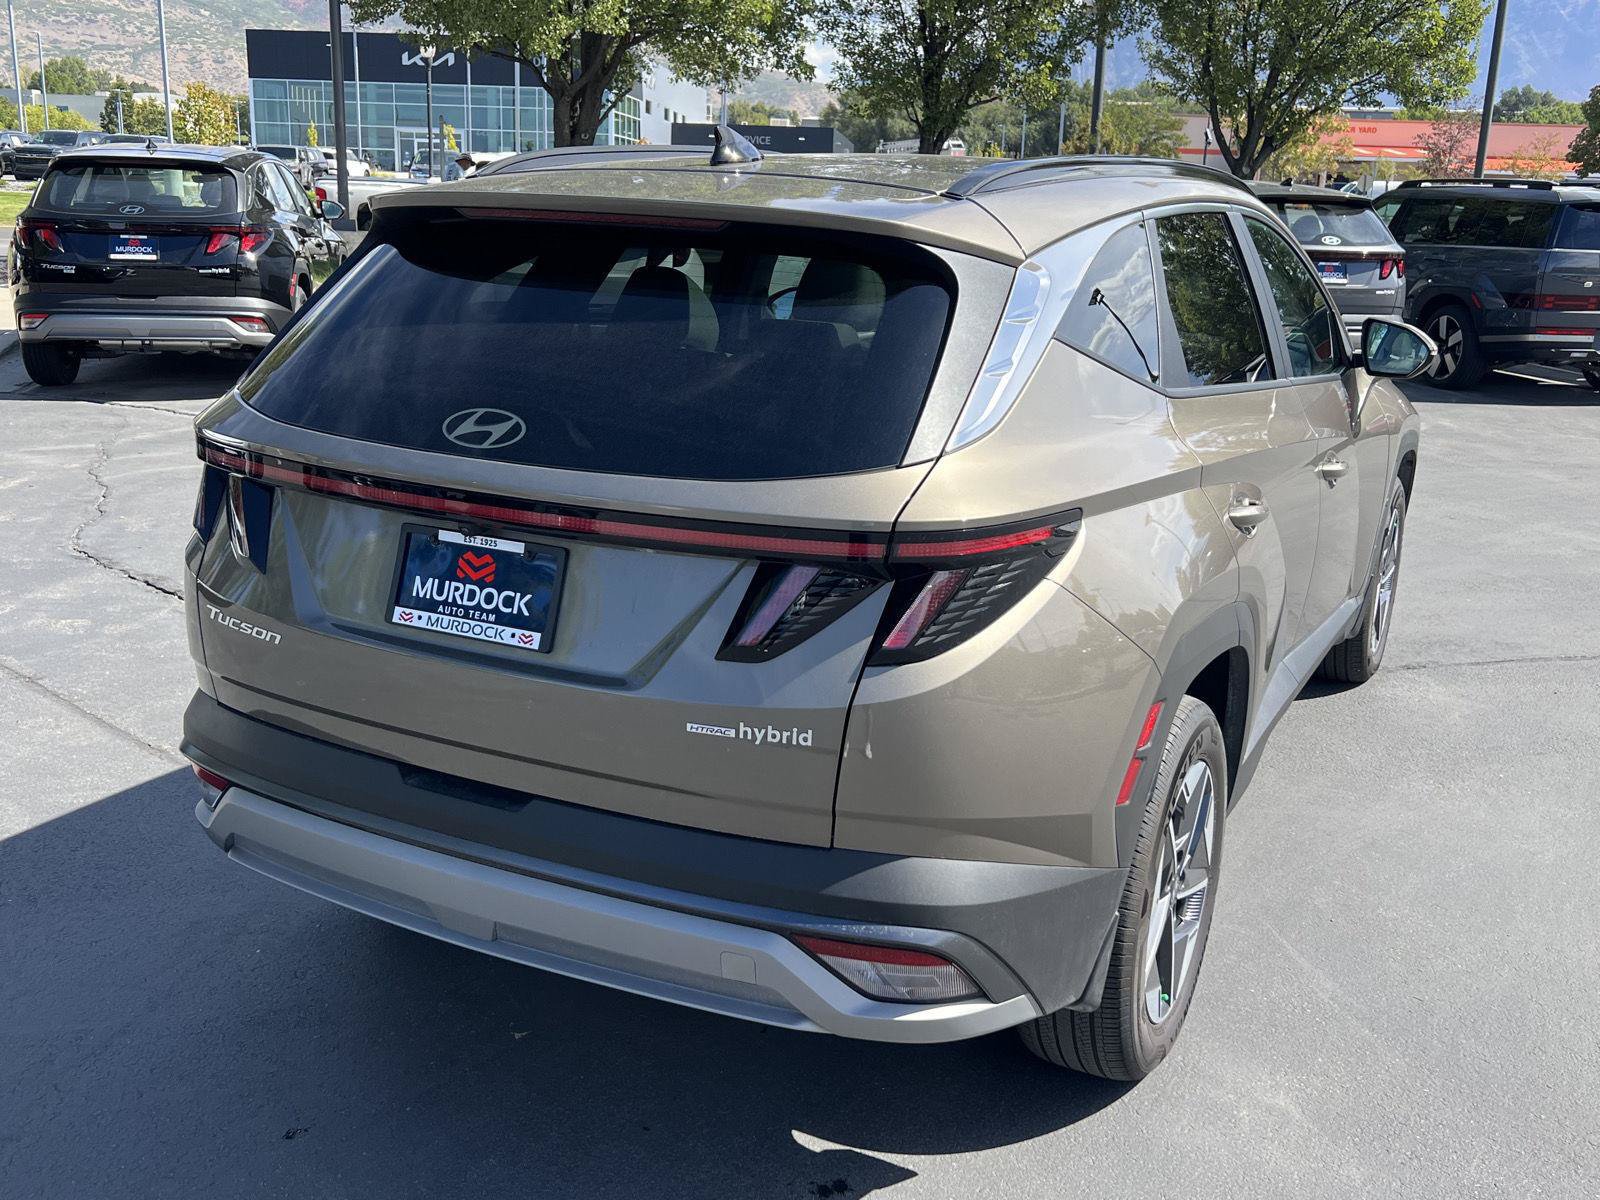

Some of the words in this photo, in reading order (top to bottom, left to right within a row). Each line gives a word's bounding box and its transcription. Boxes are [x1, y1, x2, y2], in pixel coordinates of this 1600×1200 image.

[401, 51, 455, 66] KA
[480, 538, 498, 547] 1925
[412, 575, 533, 616] MURDOCK
[437, 604, 465, 617] AUTO
[468, 610, 496, 622] TEAM
[426, 614, 506, 641] MURDOCK
[689, 724, 732, 736] HTRAC
[739, 721, 813, 746] hybrid
